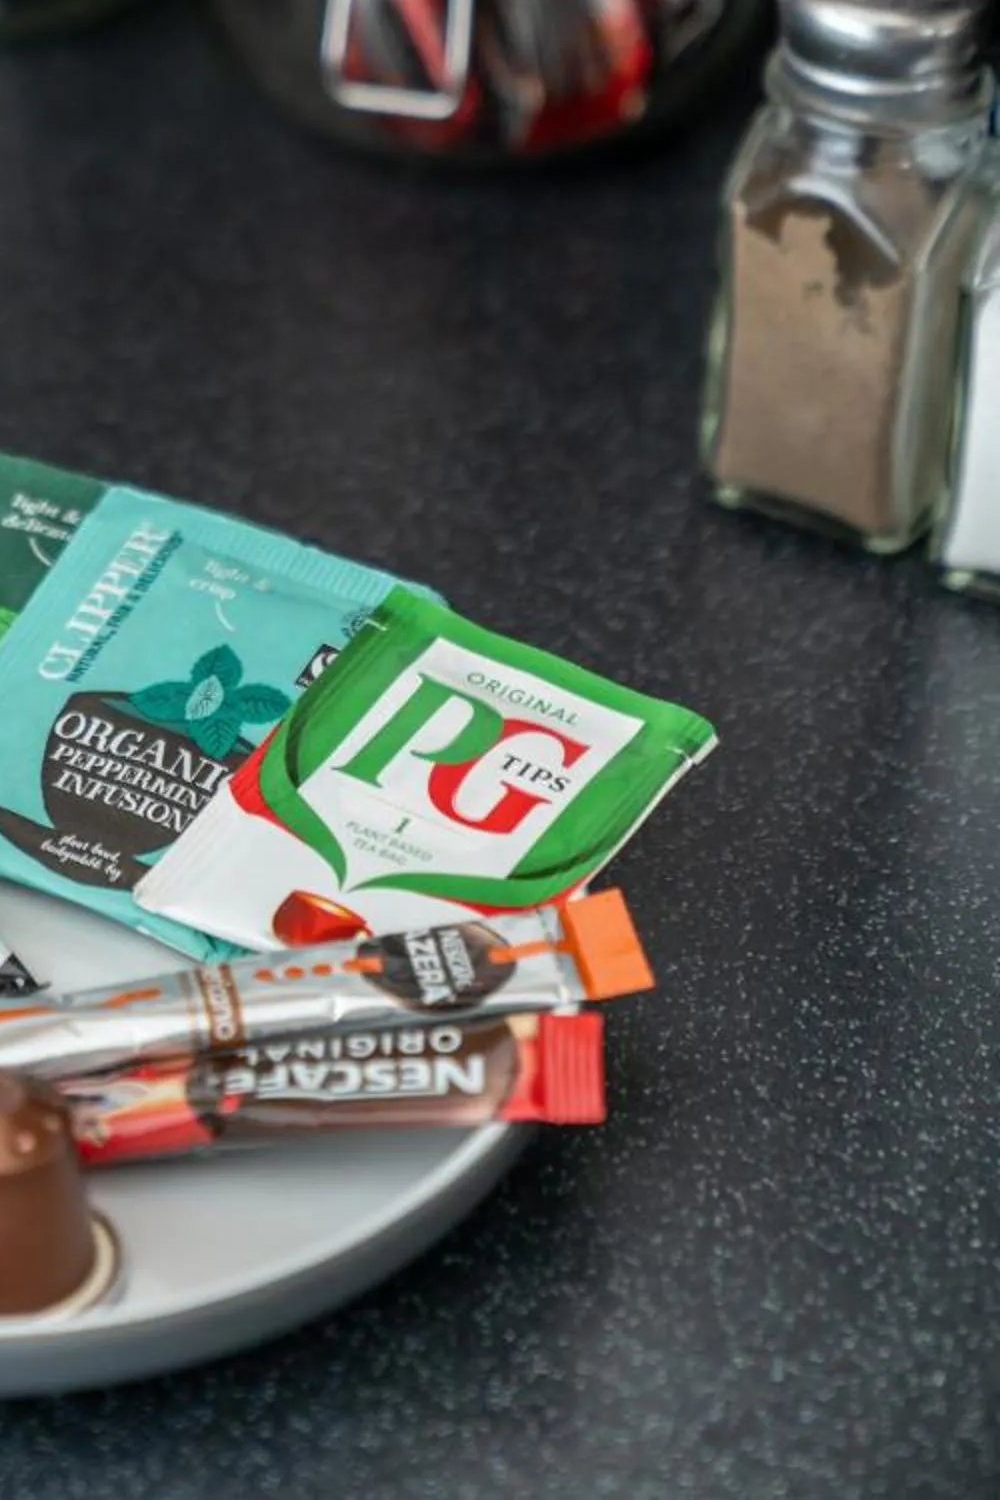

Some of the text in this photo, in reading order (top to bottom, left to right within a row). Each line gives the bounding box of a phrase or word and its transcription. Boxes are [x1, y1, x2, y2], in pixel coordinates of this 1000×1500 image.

[38, 525, 171, 679] CLIPPER
[466, 671, 581, 727] ORIGINAL
[50, 743, 212, 810] PEPPERMIN
[55, 711, 229, 792] ORGANI
[330, 672, 591, 835] PG
[501, 753, 571, 794] TIPS
[53, 769, 196, 833] INFUSION
[392, 817, 412, 835] 1
[345, 820, 434, 862] PLANT BASED
[353, 837, 379, 855] TEA
[240, 1027, 463, 1066] ORIGINAL
